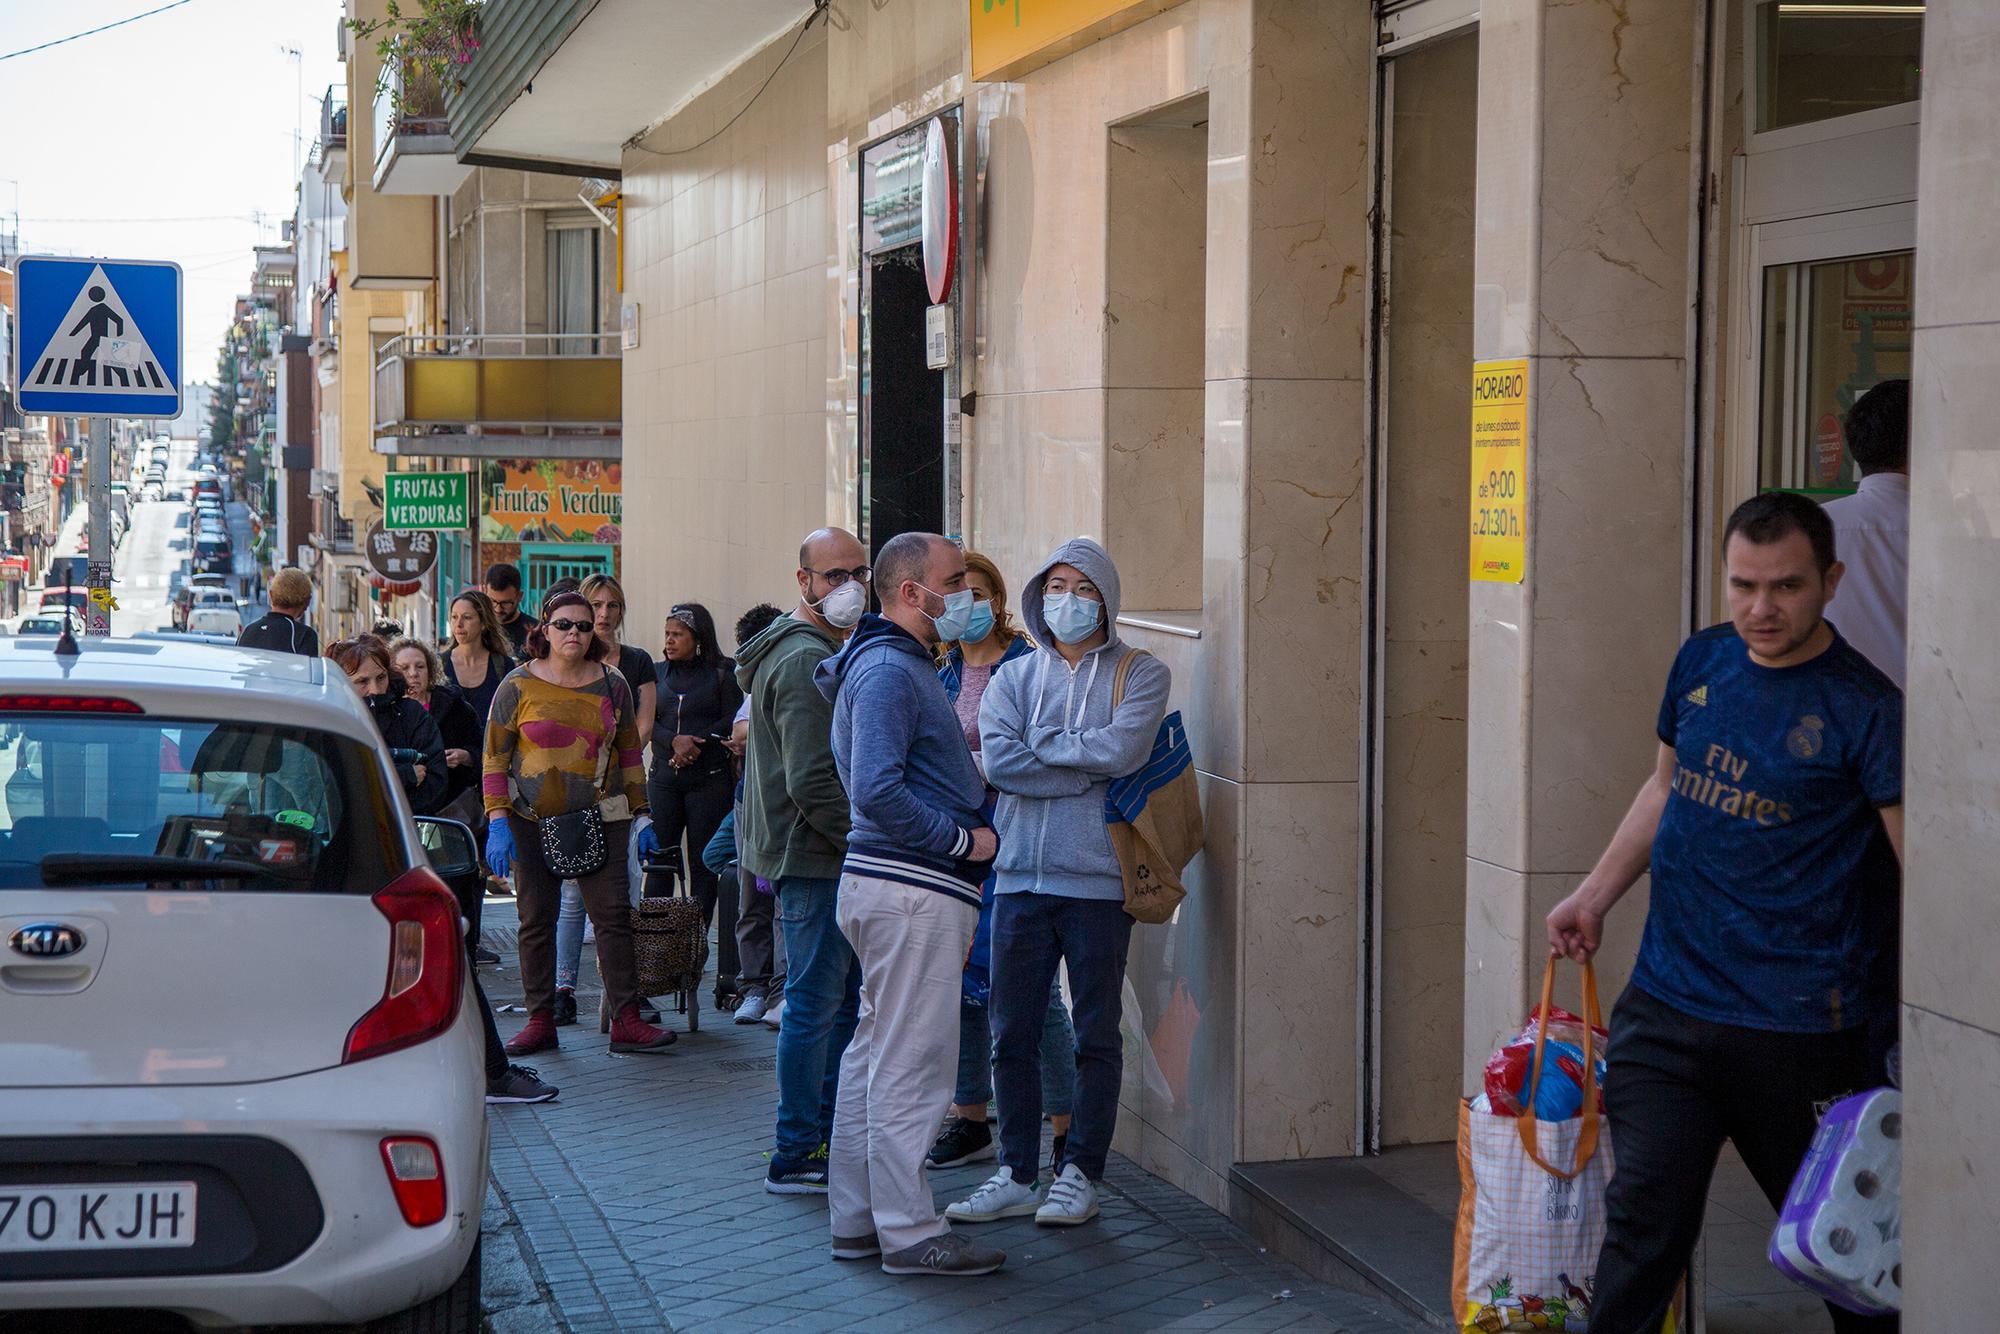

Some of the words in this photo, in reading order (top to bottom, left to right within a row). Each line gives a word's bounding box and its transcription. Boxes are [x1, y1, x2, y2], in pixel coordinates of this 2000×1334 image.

[1475, 375, 1523, 400] HORARIO
[394, 479, 445, 498] FRUTAS
[450, 479, 457, 497] Y
[1479, 481, 1488, 498] de
[1489, 470, 1515, 498] 9:00
[493, 483, 549, 512] Frutas
[391, 504, 463, 524] VERDURAS
[1479, 508, 1507, 536] 21:30
[1510, 508, 1520, 536] h.
[1706, 743, 1748, 782] Fly
[22, 931, 73, 953] KIA
[79, 1193, 180, 1240] KJH
[1547, 1204, 1579, 1221] BARRIO
